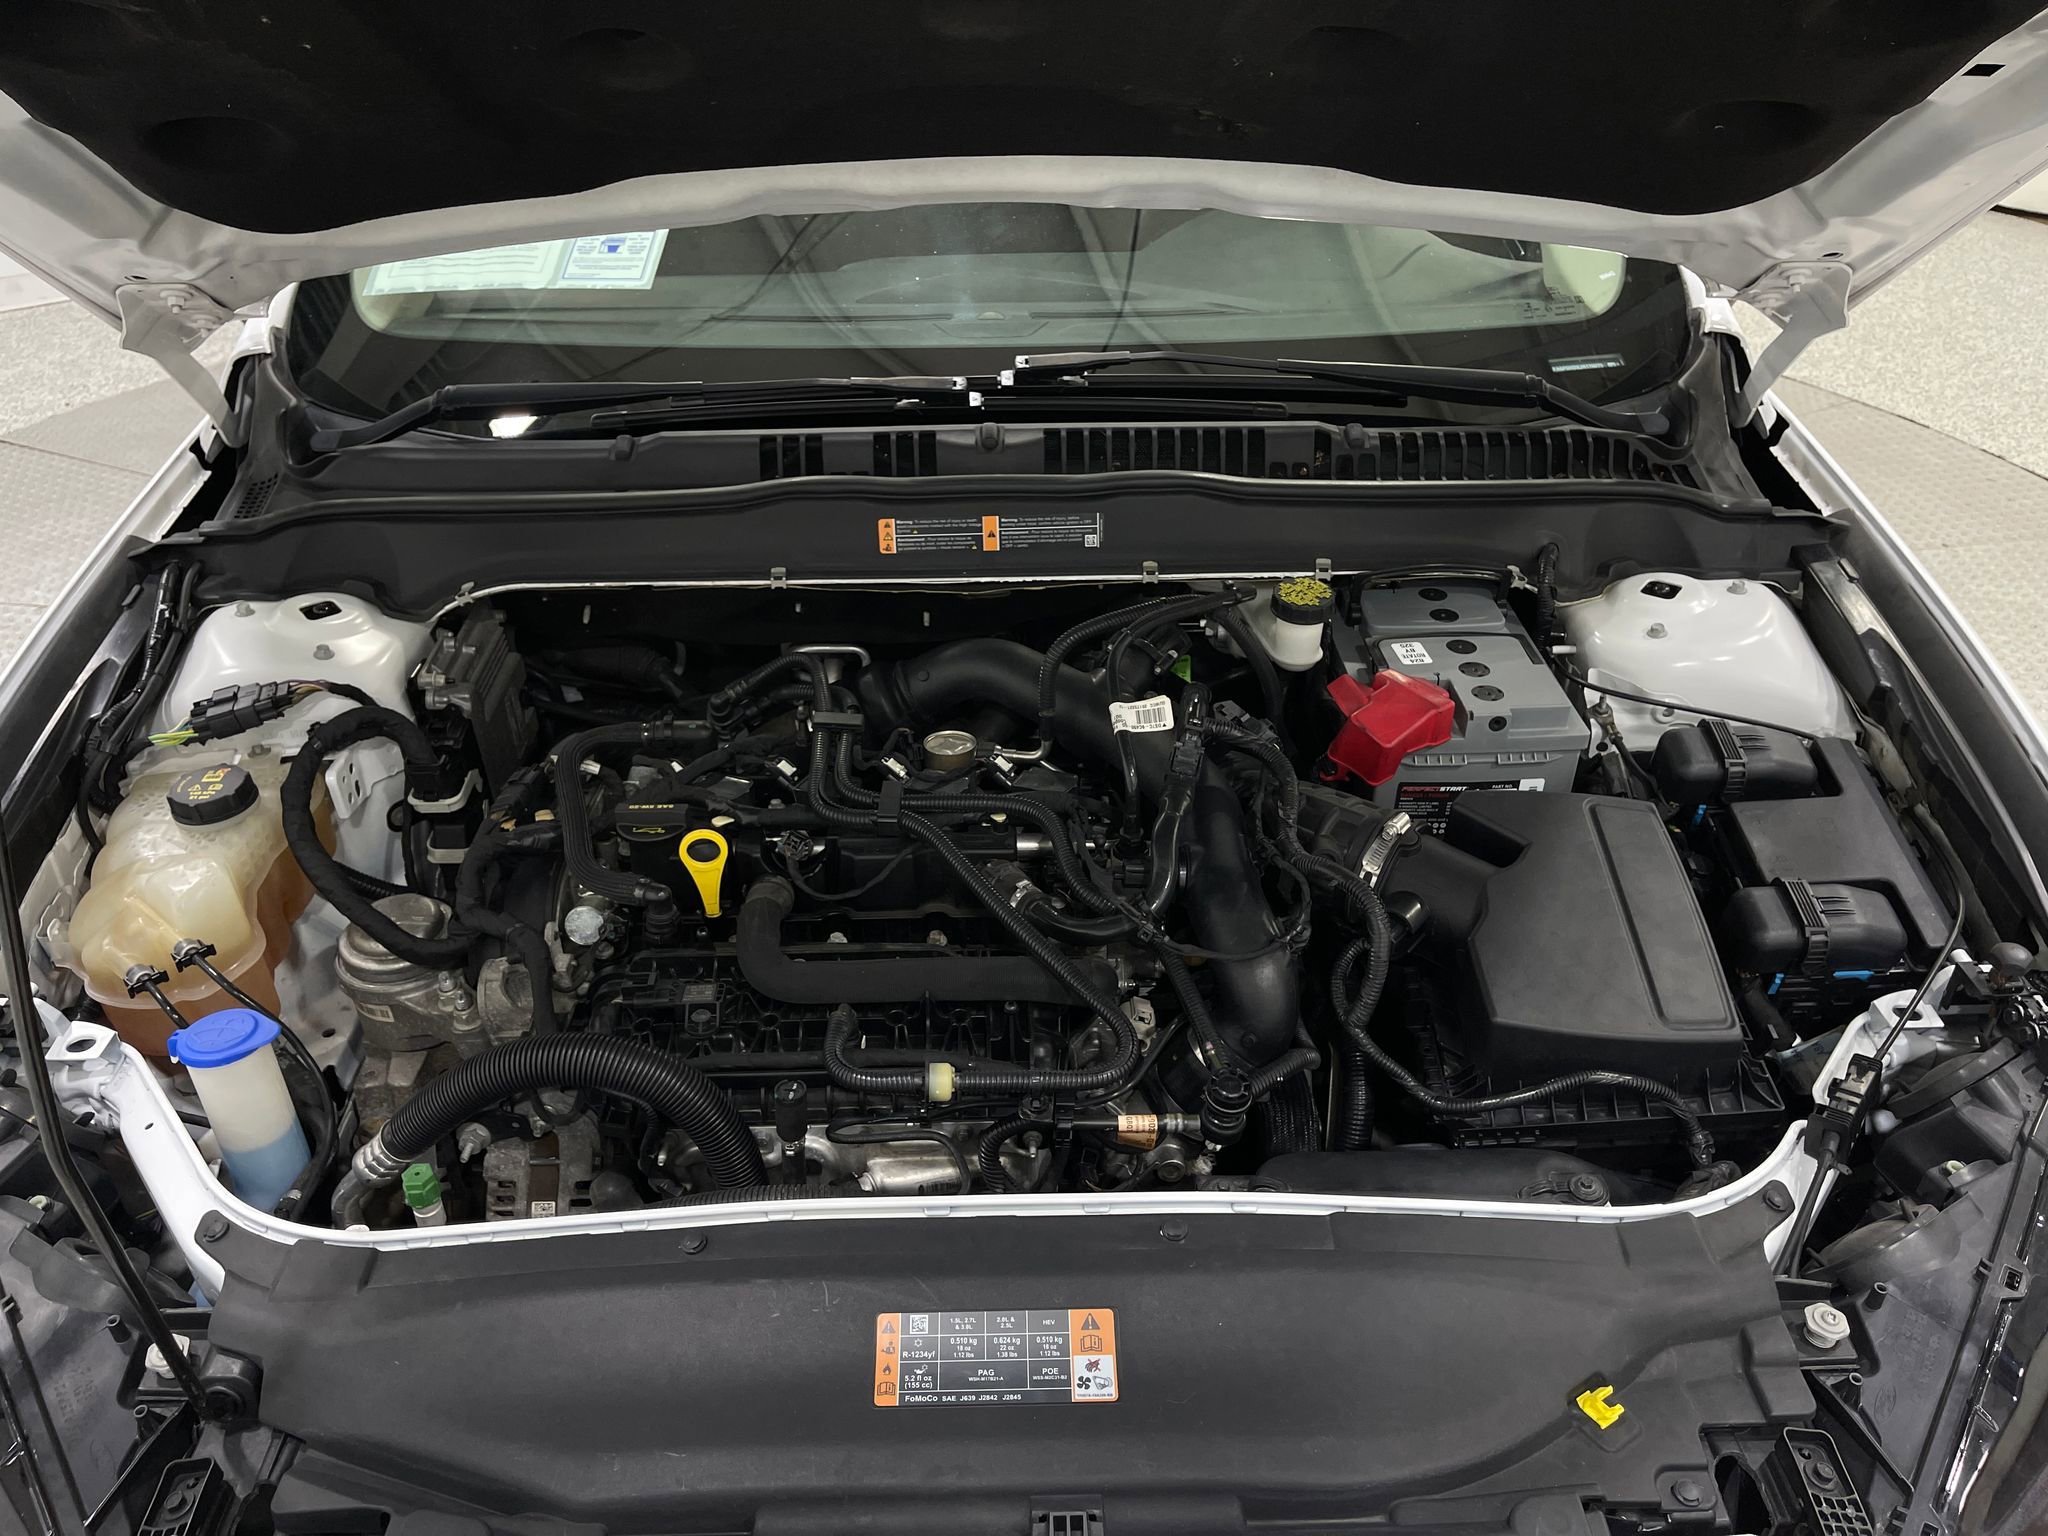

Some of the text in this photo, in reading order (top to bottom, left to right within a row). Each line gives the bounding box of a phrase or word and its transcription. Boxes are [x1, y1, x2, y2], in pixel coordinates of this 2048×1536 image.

[1012, 1337, 1020, 1345] kg
[1055, 1336, 1062, 1344] kg
[902, 1351, 935, 1359] R-1234yf
